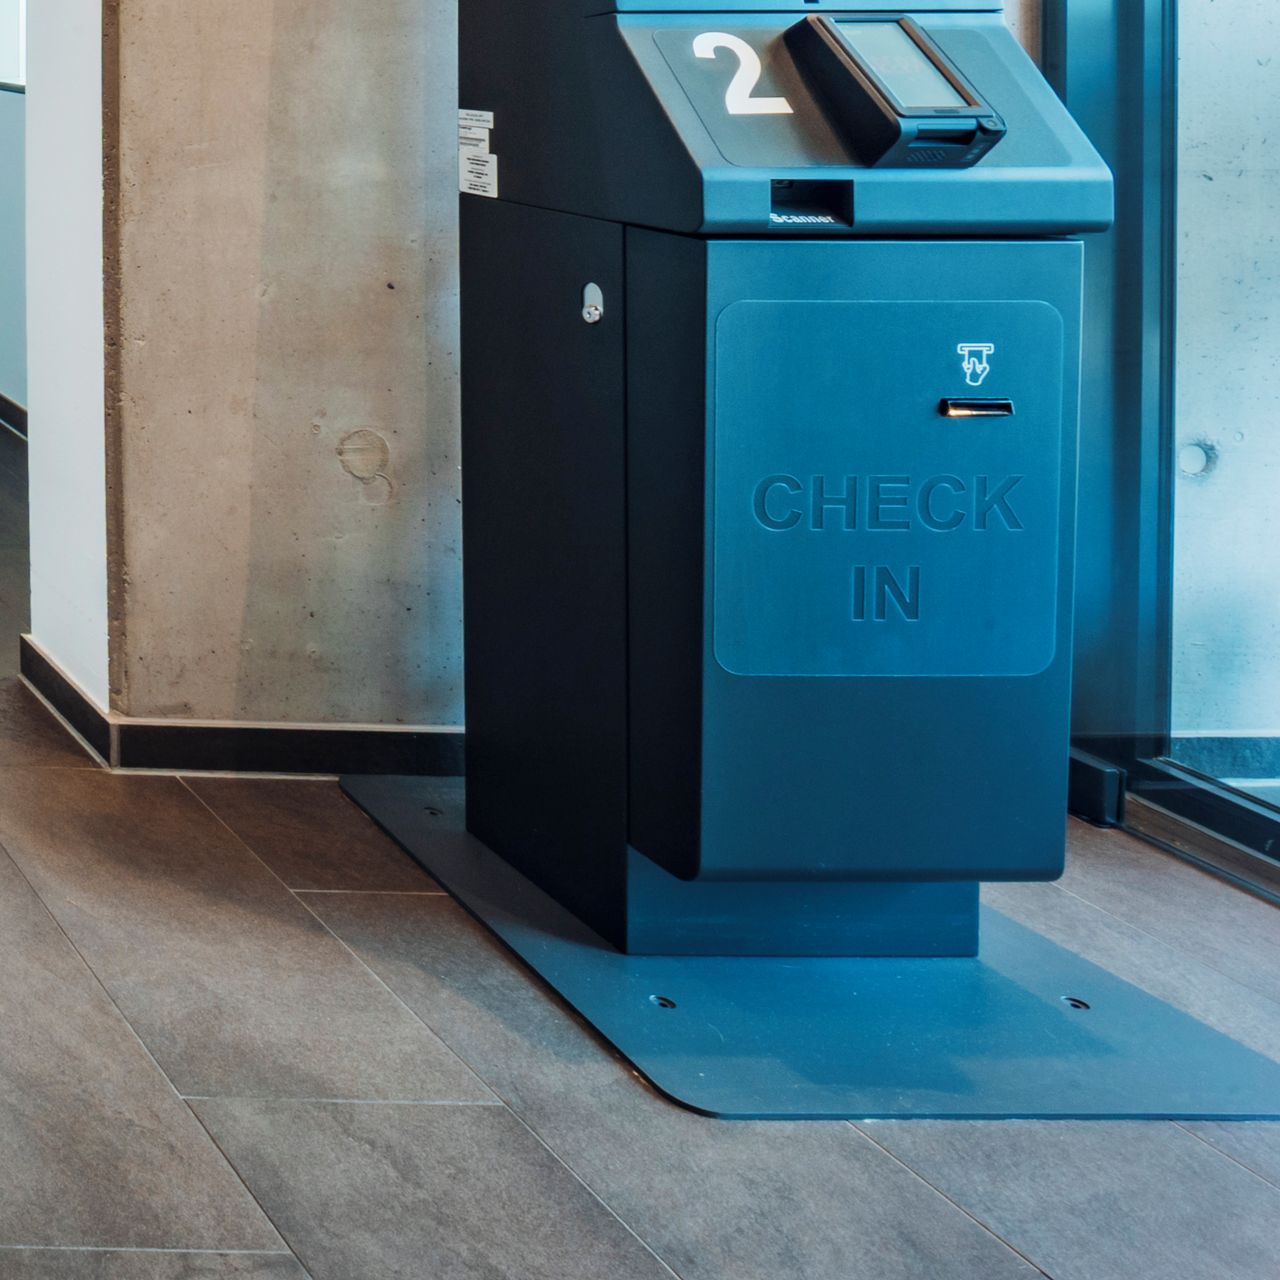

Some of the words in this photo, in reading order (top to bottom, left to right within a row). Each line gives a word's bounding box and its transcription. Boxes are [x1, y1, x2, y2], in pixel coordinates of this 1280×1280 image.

[693, 31, 794, 115] 2
[769, 213, 835, 223] Scanner
[752, 473, 1025, 532] CHECK
[851, 564, 921, 622] IN
